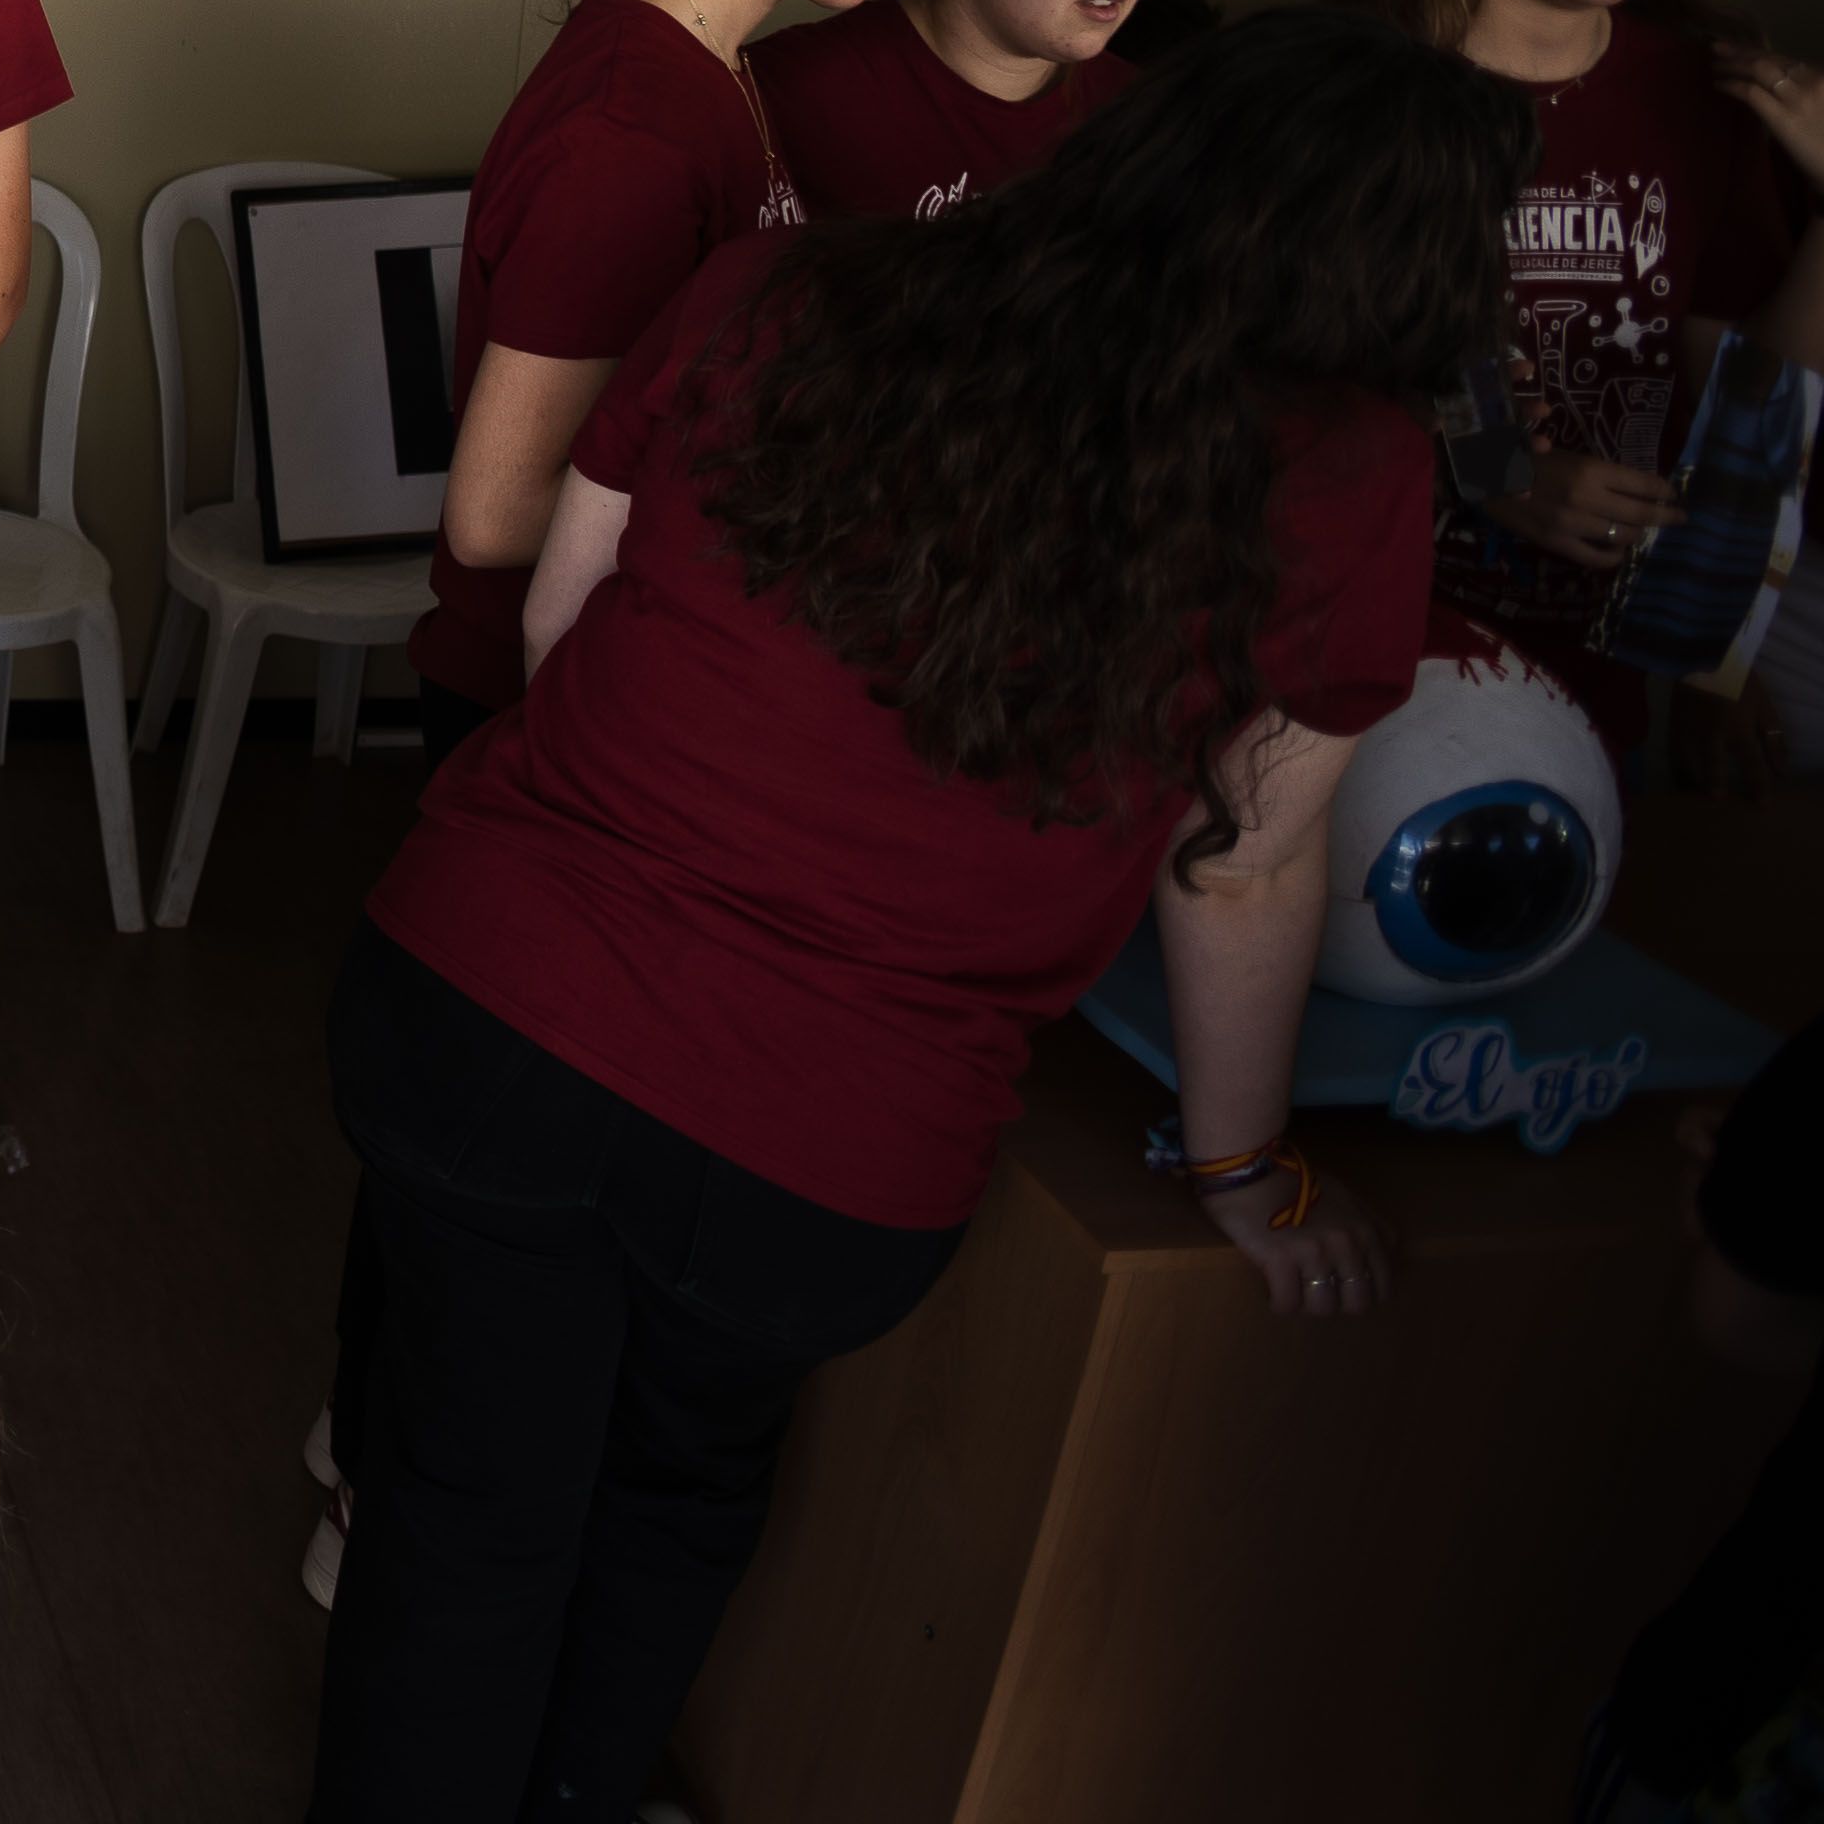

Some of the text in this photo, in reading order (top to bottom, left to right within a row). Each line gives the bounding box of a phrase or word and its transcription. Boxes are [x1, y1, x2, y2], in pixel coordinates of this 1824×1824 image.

[1503, 206, 1625, 252] CIENCIA
[1562, 258, 1578, 269] DE
[1581, 258, 1621, 270] JEREZ
[1420, 1031, 1504, 1117] El
